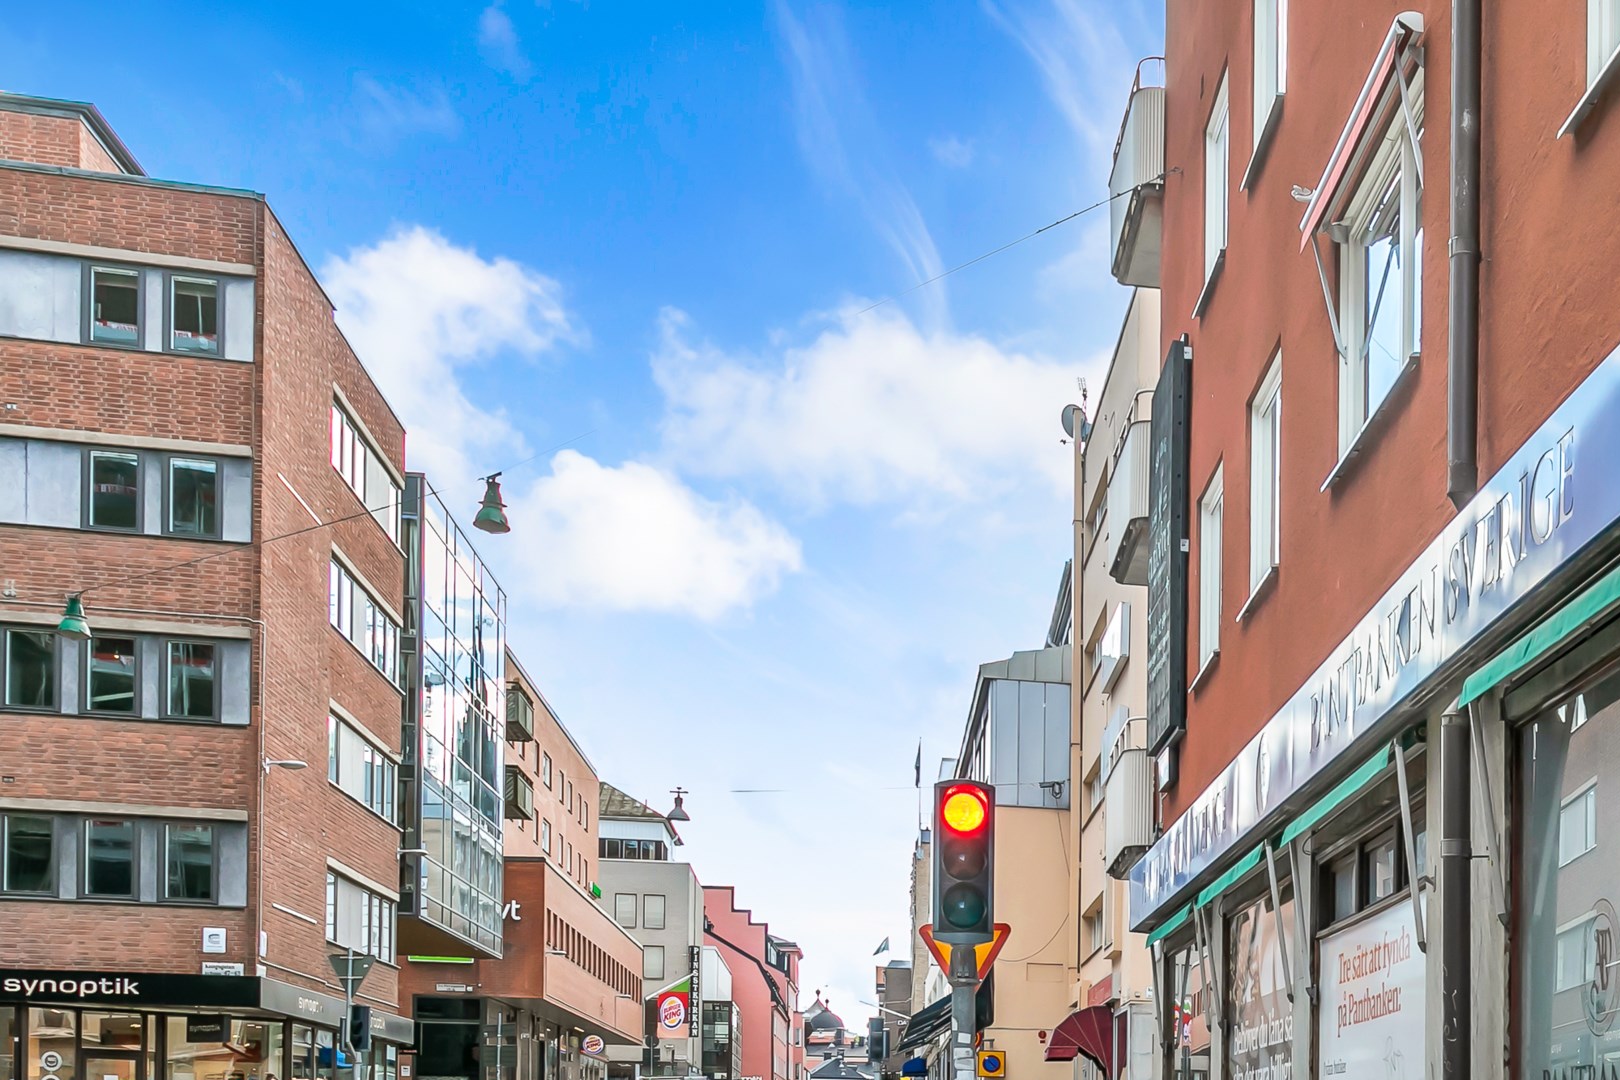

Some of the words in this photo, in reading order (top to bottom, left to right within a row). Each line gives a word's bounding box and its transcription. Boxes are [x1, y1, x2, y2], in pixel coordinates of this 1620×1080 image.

[1309, 565, 1438, 755] PANTBANKEN
[1446, 425, 1576, 626] SVERIGE
[1339, 953, 1351, 985] Tre
[1352, 944, 1368, 981] sätt
[1369, 942, 1382, 975] att
[1383, 925, 1411, 978] fynda
[4, 978, 140, 997] synoptik
[1337, 991, 1348, 1038] på
[1348, 982, 1402, 1026] Pantbanken:
[663, 1009, 681, 1022] KING
[1234, 1020, 1259, 1055] Behöver
[1259, 1015, 1268, 1049] du
[1269, 1007, 1284, 1045] låna
